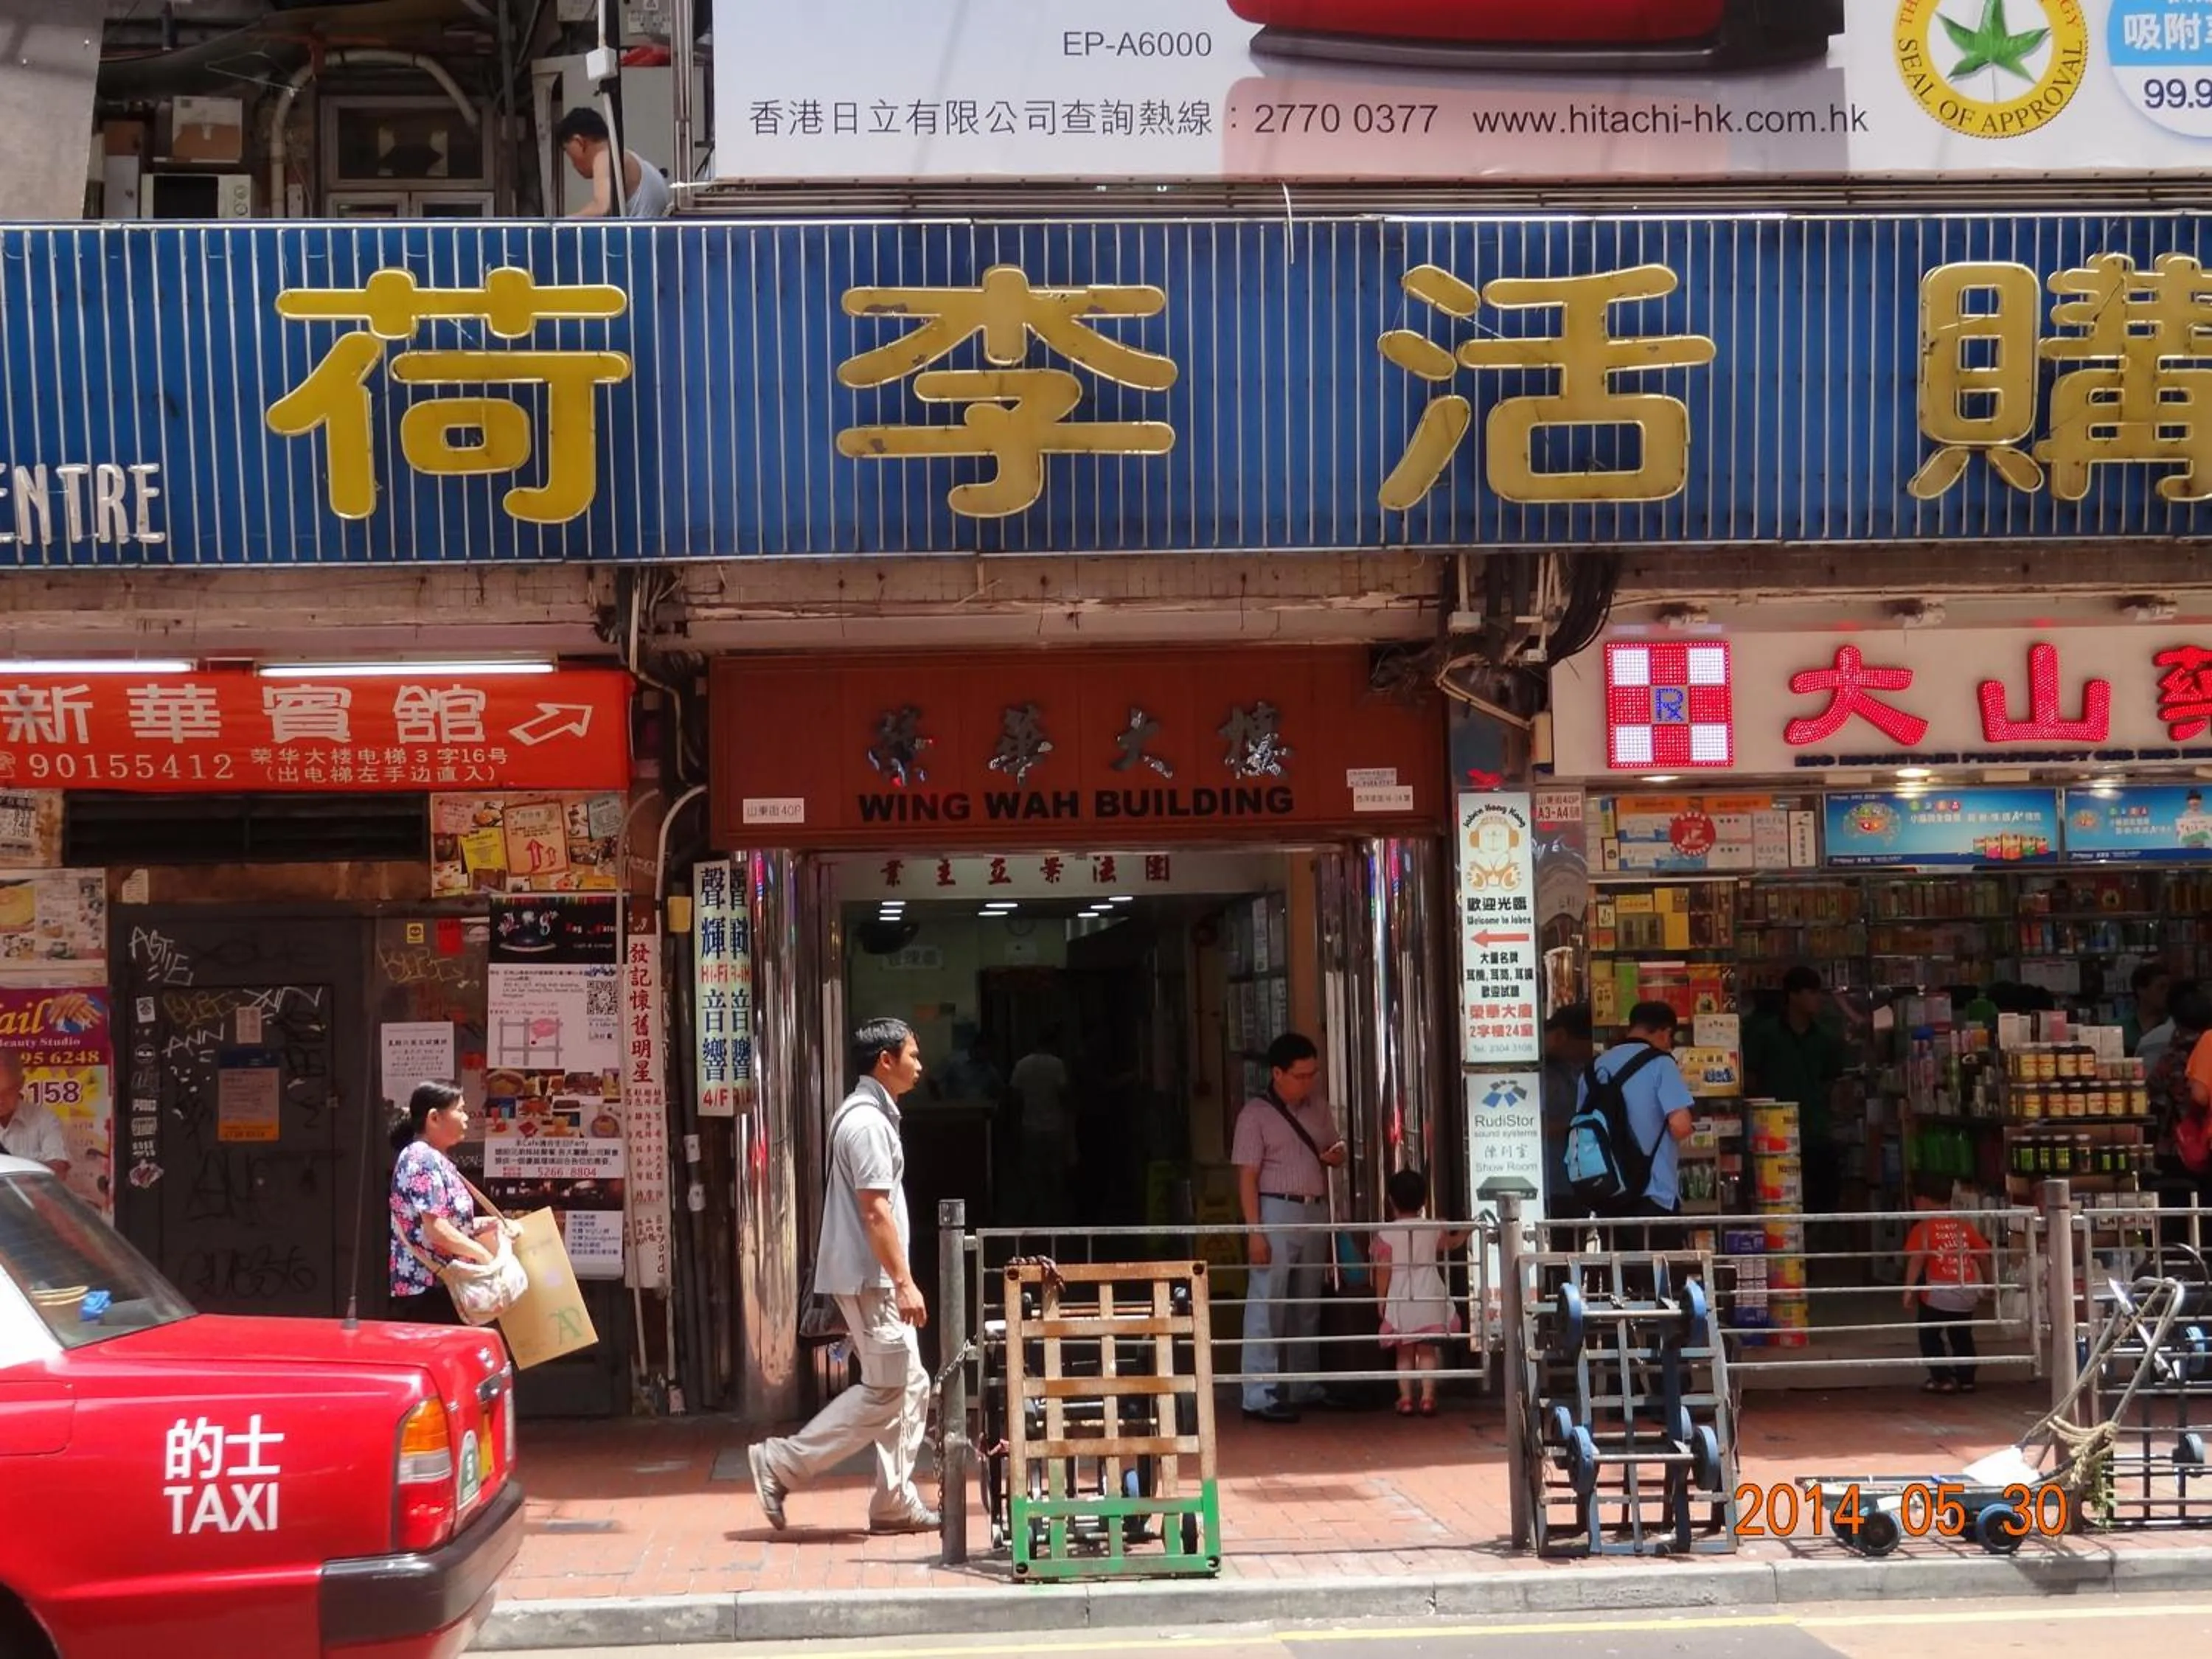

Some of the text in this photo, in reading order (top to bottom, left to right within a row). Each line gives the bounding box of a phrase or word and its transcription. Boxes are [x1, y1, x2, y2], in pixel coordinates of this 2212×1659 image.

[1062, 32, 1213, 59] EP-A6000
[2124, 12, 2212, 52] 吸附
[1898, 38, 2084, 133] SEAL OF APPROVAL
[1253, 104, 1340, 134] 2770
[1352, 104, 1438, 134] 0377
[1473, 103, 1869, 135] www.hitachi-hk.com.hk
[0, 683, 487, 745] 新華賓館
[30, 753, 235, 781] 90155412
[858, 785, 1295, 824] WING WAH BUILDING
[1467, 896, 1528, 912] 歡迎光臨
[700, 962, 728, 984] Hi-Fi
[0, 998, 52, 1034] ail
[39, 1037, 81, 1047] Studio
[700, 988, 728, 1082] 音響
[50, 1050, 100, 1064] 6248
[702, 1088, 728, 1107] 4/F
[1474, 1114, 1535, 1127] RudiStor
[1506, 1161, 1538, 1172] Room
[164, 1413, 285, 1481] 的士
[163, 1481, 279, 1534] TAXI
